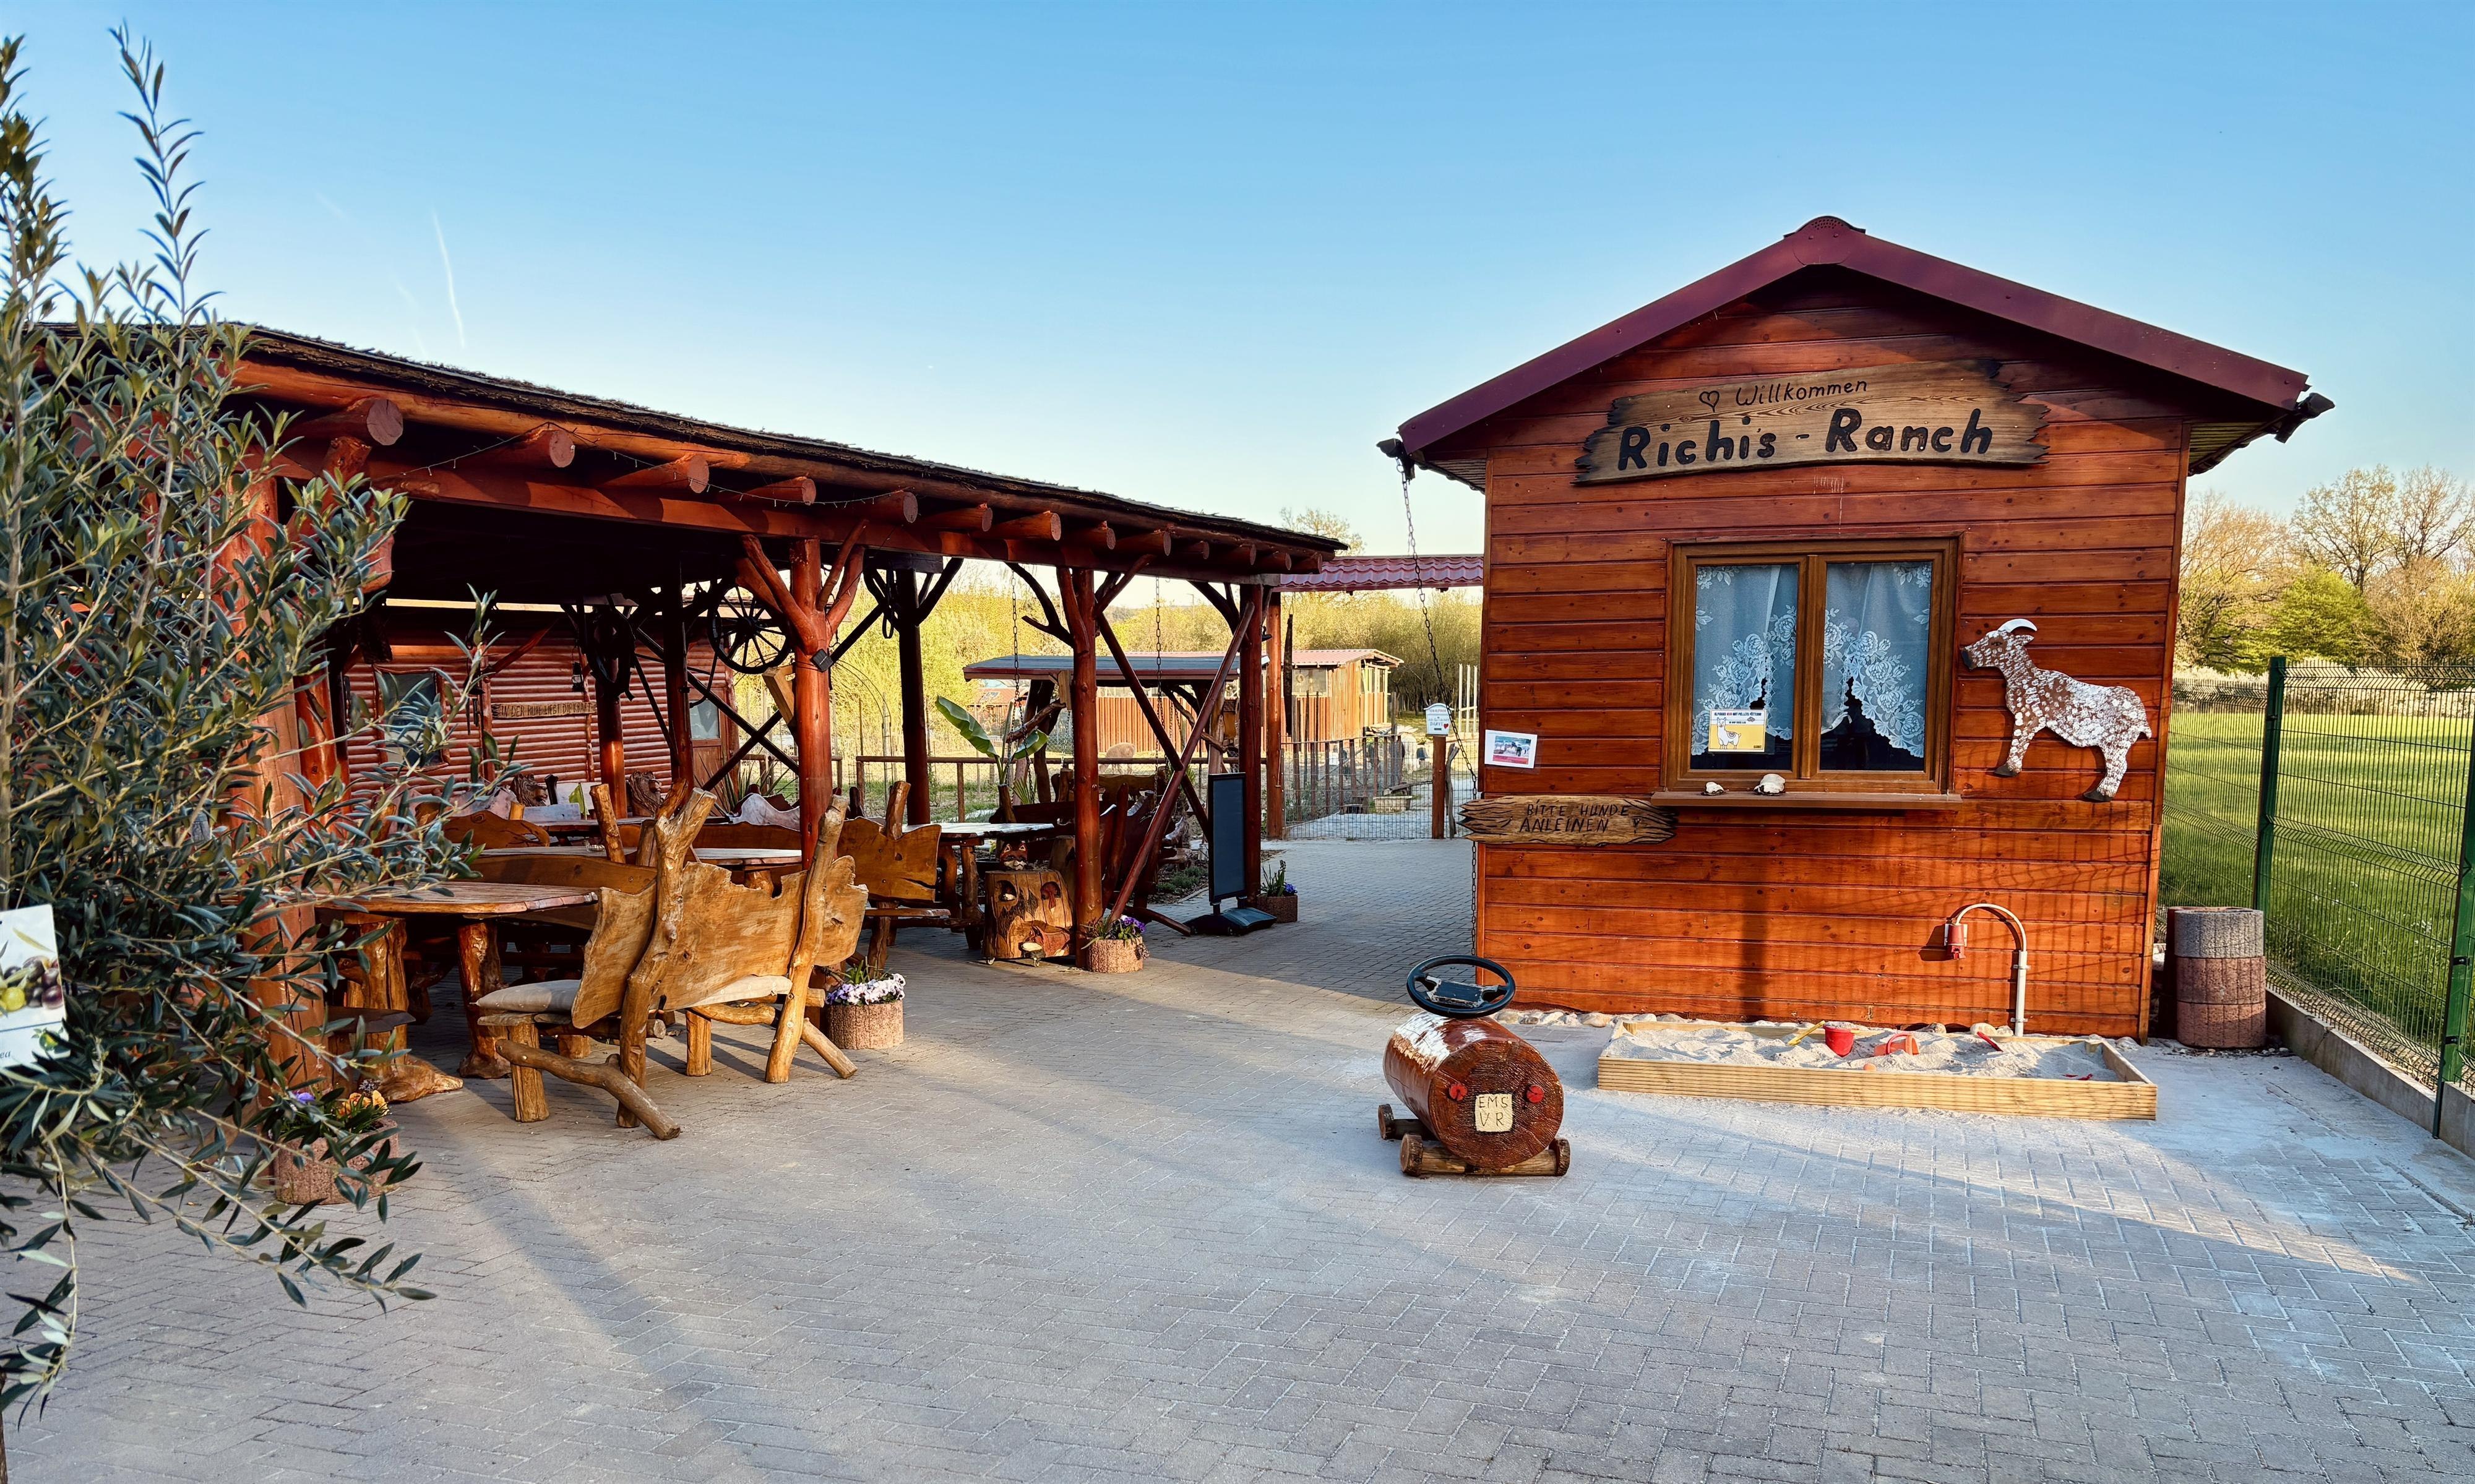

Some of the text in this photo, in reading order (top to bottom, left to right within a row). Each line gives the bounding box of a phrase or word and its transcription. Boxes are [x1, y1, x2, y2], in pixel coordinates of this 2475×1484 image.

[1735, 379, 1867, 406] Willkommen
[1825, 408, 1992, 454] Ranch
[511, 705, 525, 717] DER
[573, 702, 591, 713] KRAFT
[1527, 799, 1630, 816] BITTE HUNDE
[1519, 817, 1609, 833] ANLEINEN
[1479, 1096, 1509, 1109] EMS
